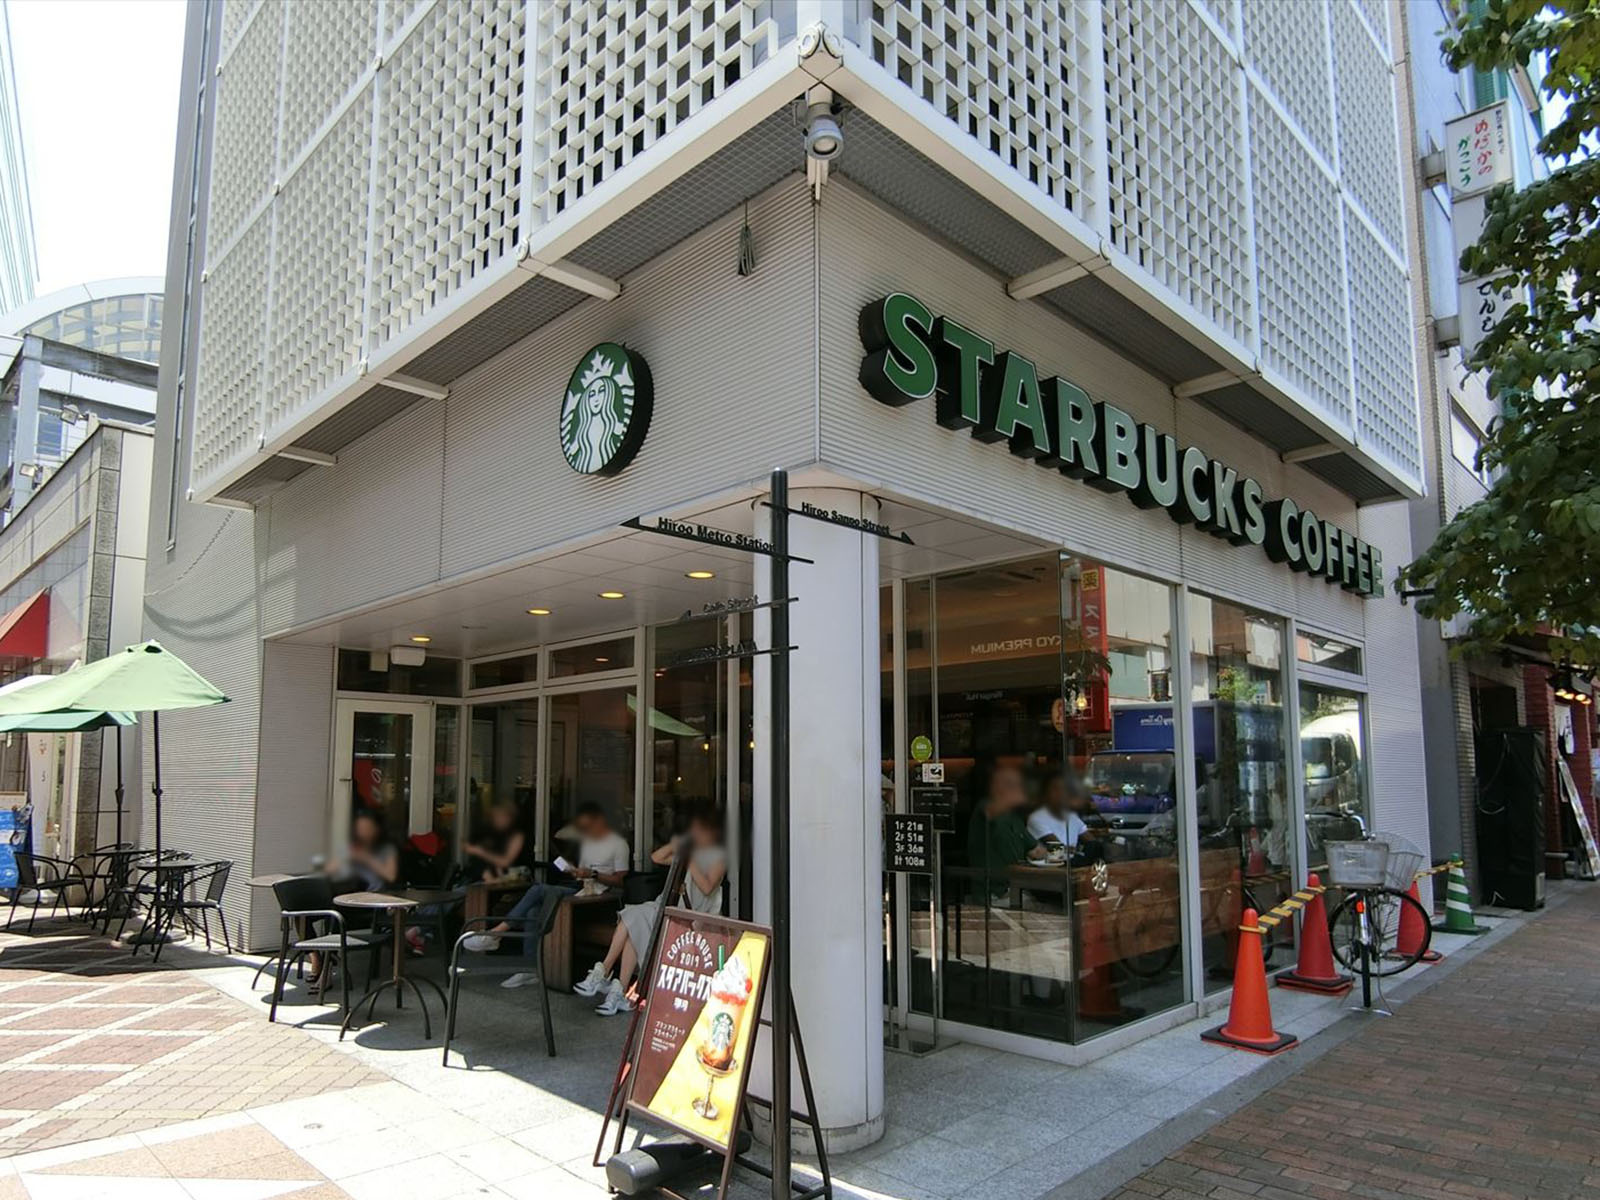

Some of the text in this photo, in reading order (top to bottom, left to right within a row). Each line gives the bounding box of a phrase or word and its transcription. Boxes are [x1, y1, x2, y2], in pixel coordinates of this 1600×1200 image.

[881, 292, 1385, 599] STARBUCKS COFFEE
[657, 516, 776, 551] Hiroo Metro Station
[801, 502, 829, 519] Hiroo
[861, 518, 890, 534] Street
[666, 931, 714, 969] COFFEE HOUSE
[680, 952, 700, 968] 2019
